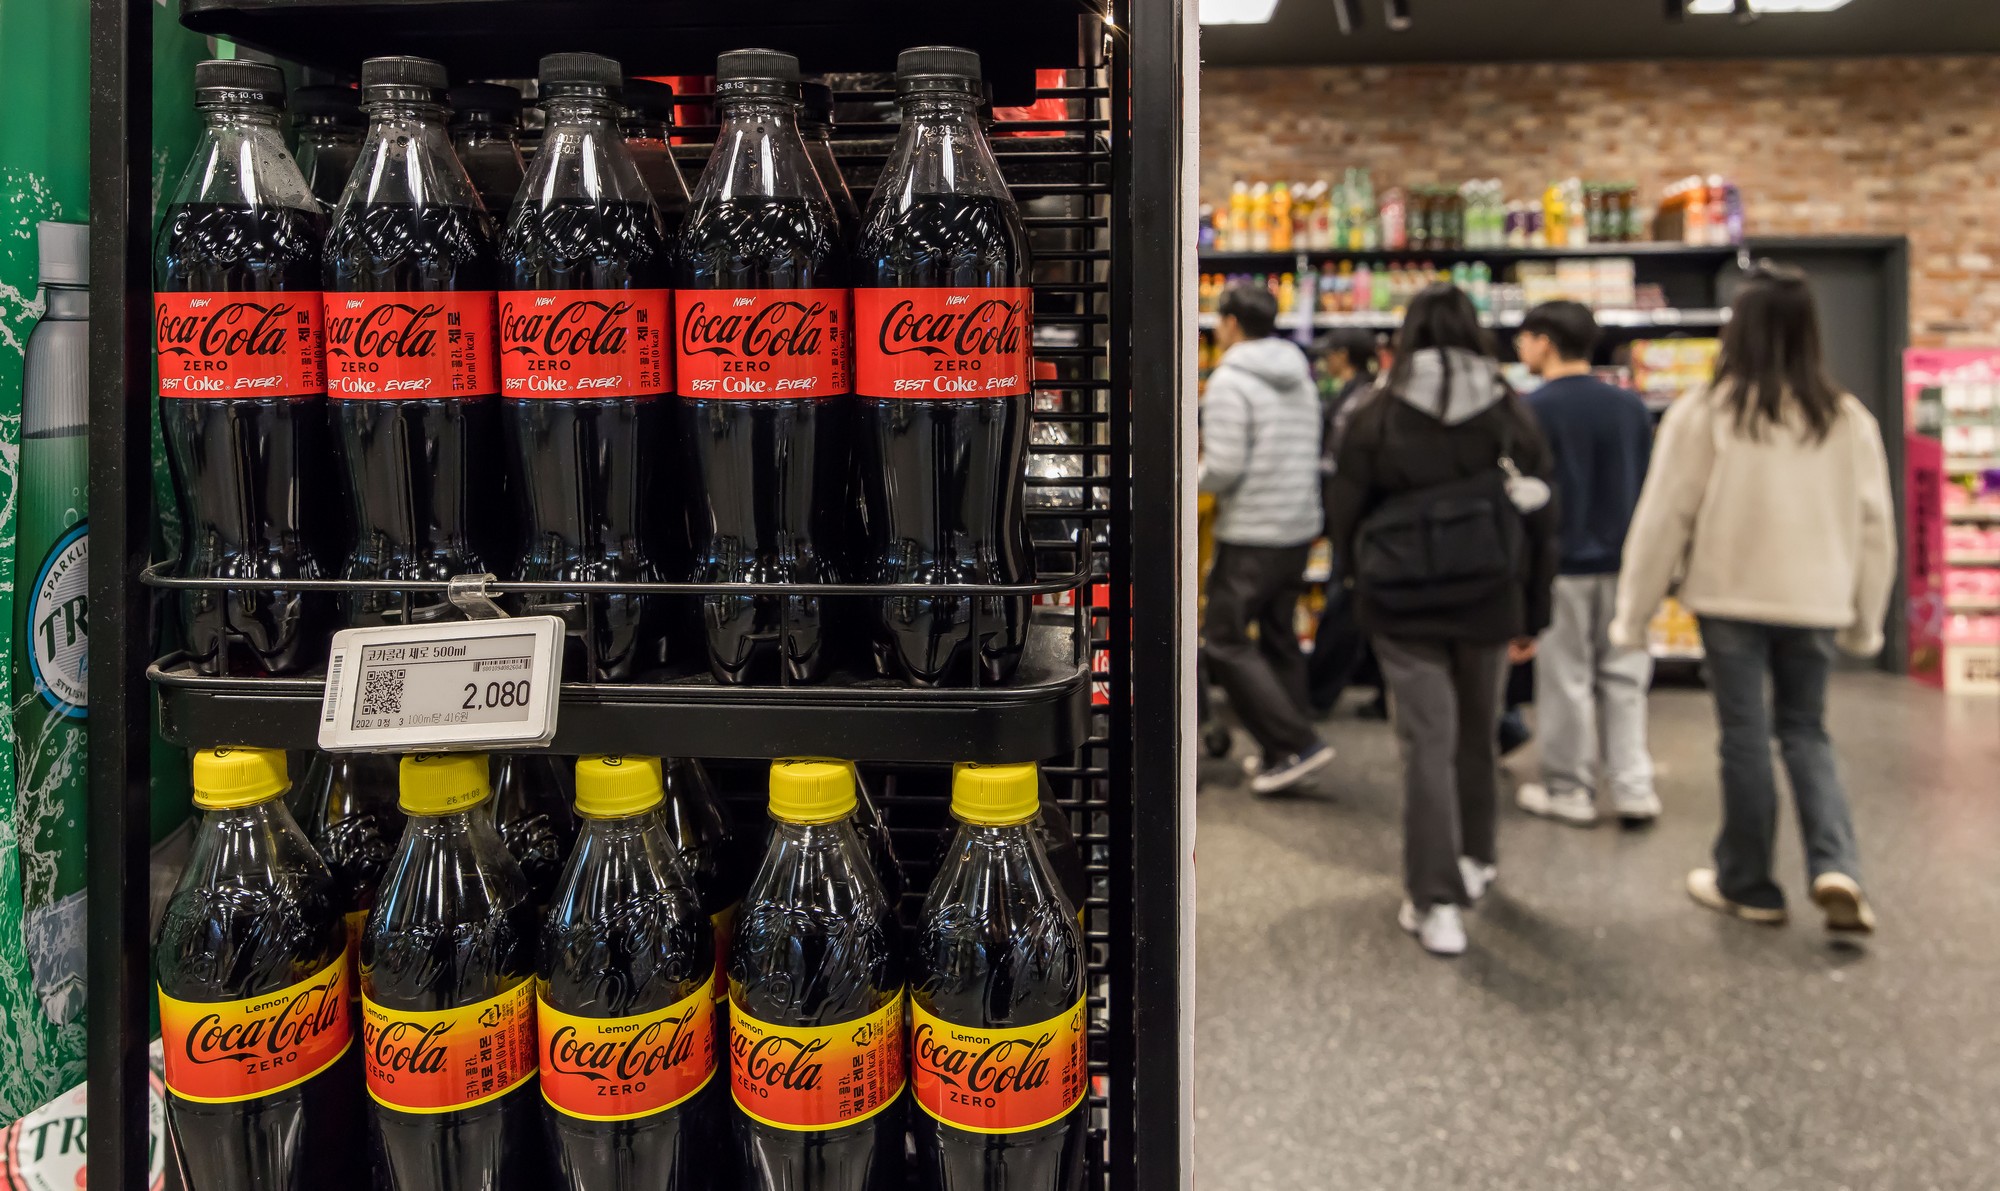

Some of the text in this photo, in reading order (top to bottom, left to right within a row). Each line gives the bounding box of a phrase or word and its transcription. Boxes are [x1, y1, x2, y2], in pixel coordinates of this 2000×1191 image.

[219, 91, 263, 100] 26.10.13
[190, 298, 212, 308] NEW
[345, 299, 365, 309] NEW
[534, 296, 556, 307] NEW
[732, 297, 756, 307] NEW
[945, 294, 970, 306] NEW
[297, 310, 310, 342] 제로
[447, 311, 461, 344] 제로
[501, 301, 636, 356] Coca-Cola
[636, 308, 648, 341] 제로
[682, 301, 829, 357] Coca-Cola
[829, 309, 838, 342] 제로
[879, 300, 1024, 356] Coca-Cola
[464, 332, 475, 351] kcal)
[650, 329, 660, 349] kcal)
[183, 360, 228, 371] ZERO
[341, 362, 379, 372] ZERO
[467, 362, 476, 373] ml
[527, 360, 571, 371] ZERO
[651, 358, 660, 370] ml
[723, 361, 771, 372] ZERO
[933, 360, 981, 371] ZERO
[162, 375, 283, 391] BEST Coke EVER?
[341, 376, 376, 392] Coke
[384, 378, 432, 392] EVER?
[467, 374, 477, 390] 500
[505, 375, 623, 391] BEST Coke EVER?
[651, 371, 661, 387] 500
[691, 376, 818, 393] BEST Coke EVER?
[893, 375, 1019, 392] BEST Coke EVER?
[44, 542, 87, 600] SPARKLI
[40, 595, 88, 663] TR
[366, 645, 467, 661] 코카콜라 제로 500ml
[462, 679, 531, 711] 2,080
[245, 996, 289, 1014] Lemon
[185, 970, 341, 1064] Coca-Cola
[366, 1006, 389, 1022] Lemon
[597, 1023, 640, 1034] Lemon
[737, 1015, 764, 1036] Lemon
[550, 1001, 700, 1081] Coca-Cola
[951, 1030, 990, 1045] Lemon
[480, 1034, 492, 1063] 레몬
[246, 1051, 297, 1075] ZERO
[914, 1023, 1058, 1094] Coca-Cola
[368, 1061, 395, 1084] ZERO
[852, 1054, 864, 1082] 레몬
[481, 1064, 494, 1093] 제로
[498, 1071, 508, 1088] 500
[737, 1072, 769, 1099] ZERO
[597, 1081, 647, 1096] ZERO
[853, 1084, 865, 1113] 제로
[867, 1091, 877, 1109] 500
[950, 1091, 996, 1108] ZERO
[28, 1115, 87, 1163] TR
